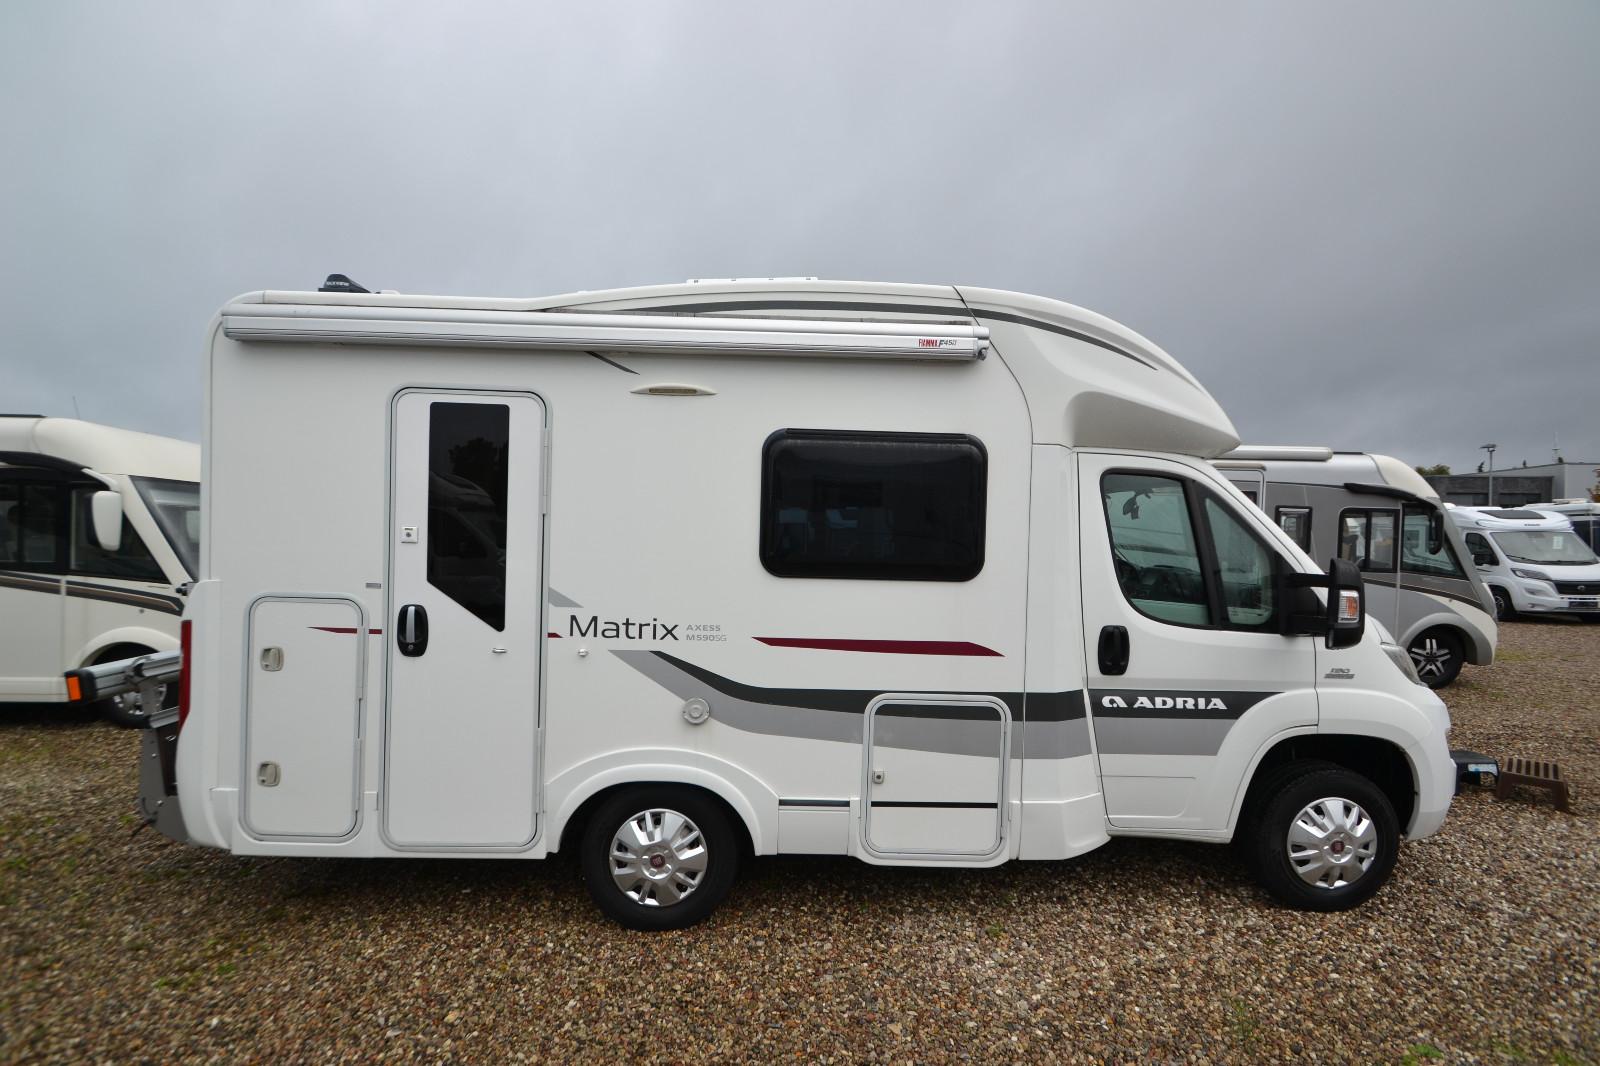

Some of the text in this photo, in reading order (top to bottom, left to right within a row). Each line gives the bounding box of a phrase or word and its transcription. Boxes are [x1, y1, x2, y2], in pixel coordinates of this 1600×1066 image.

[569, 614, 680, 641] Matrix
[686, 624, 721, 632] AXESS
[686, 634, 728, 642] M590SG
[1132, 696, 1228, 710] ADRIA
